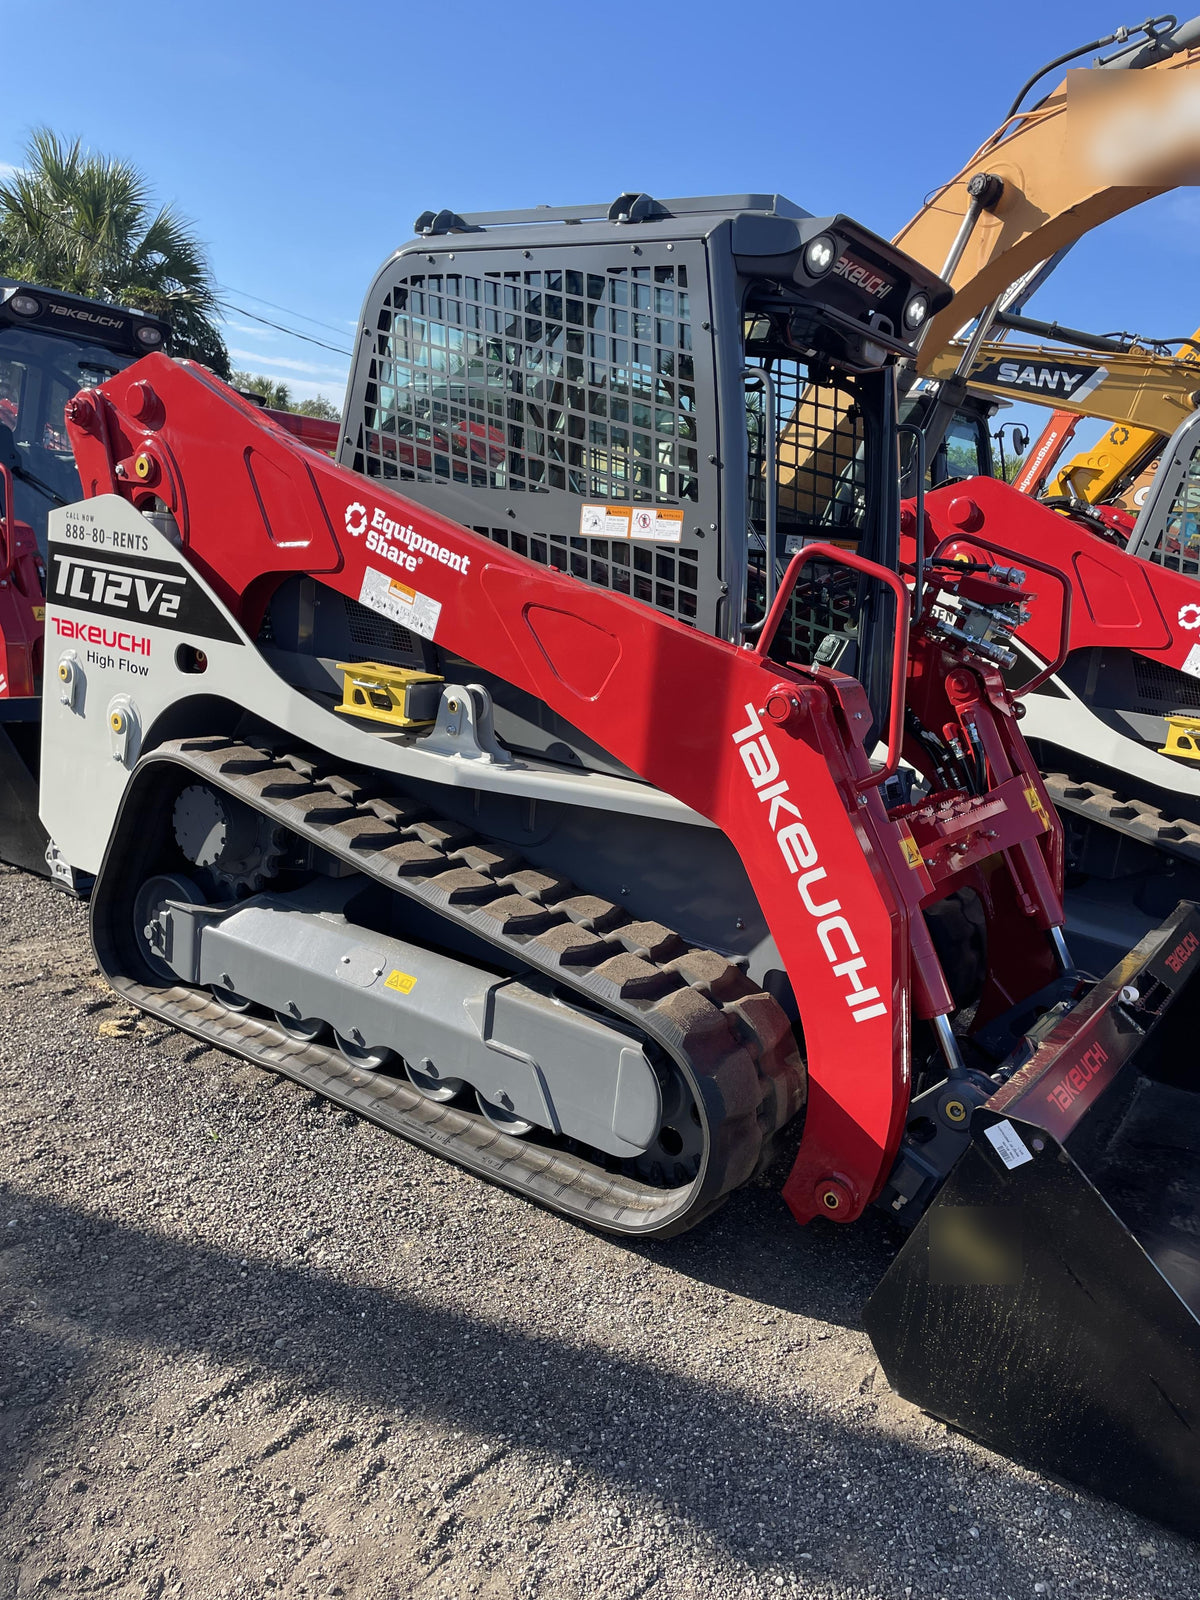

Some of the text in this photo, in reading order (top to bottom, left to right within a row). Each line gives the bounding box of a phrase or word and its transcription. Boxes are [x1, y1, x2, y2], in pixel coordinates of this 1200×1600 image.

[831, 256, 893, 299] AKEUCHI
[997, 363, 1083, 392] SANY
[66, 511, 95, 522] CALL NOW
[65, 523, 149, 551] 888-80-RENTS
[371, 507, 471, 576] Equipment
[53, 554, 187, 619] TL12V2
[87, 650, 149, 676] High Flow
